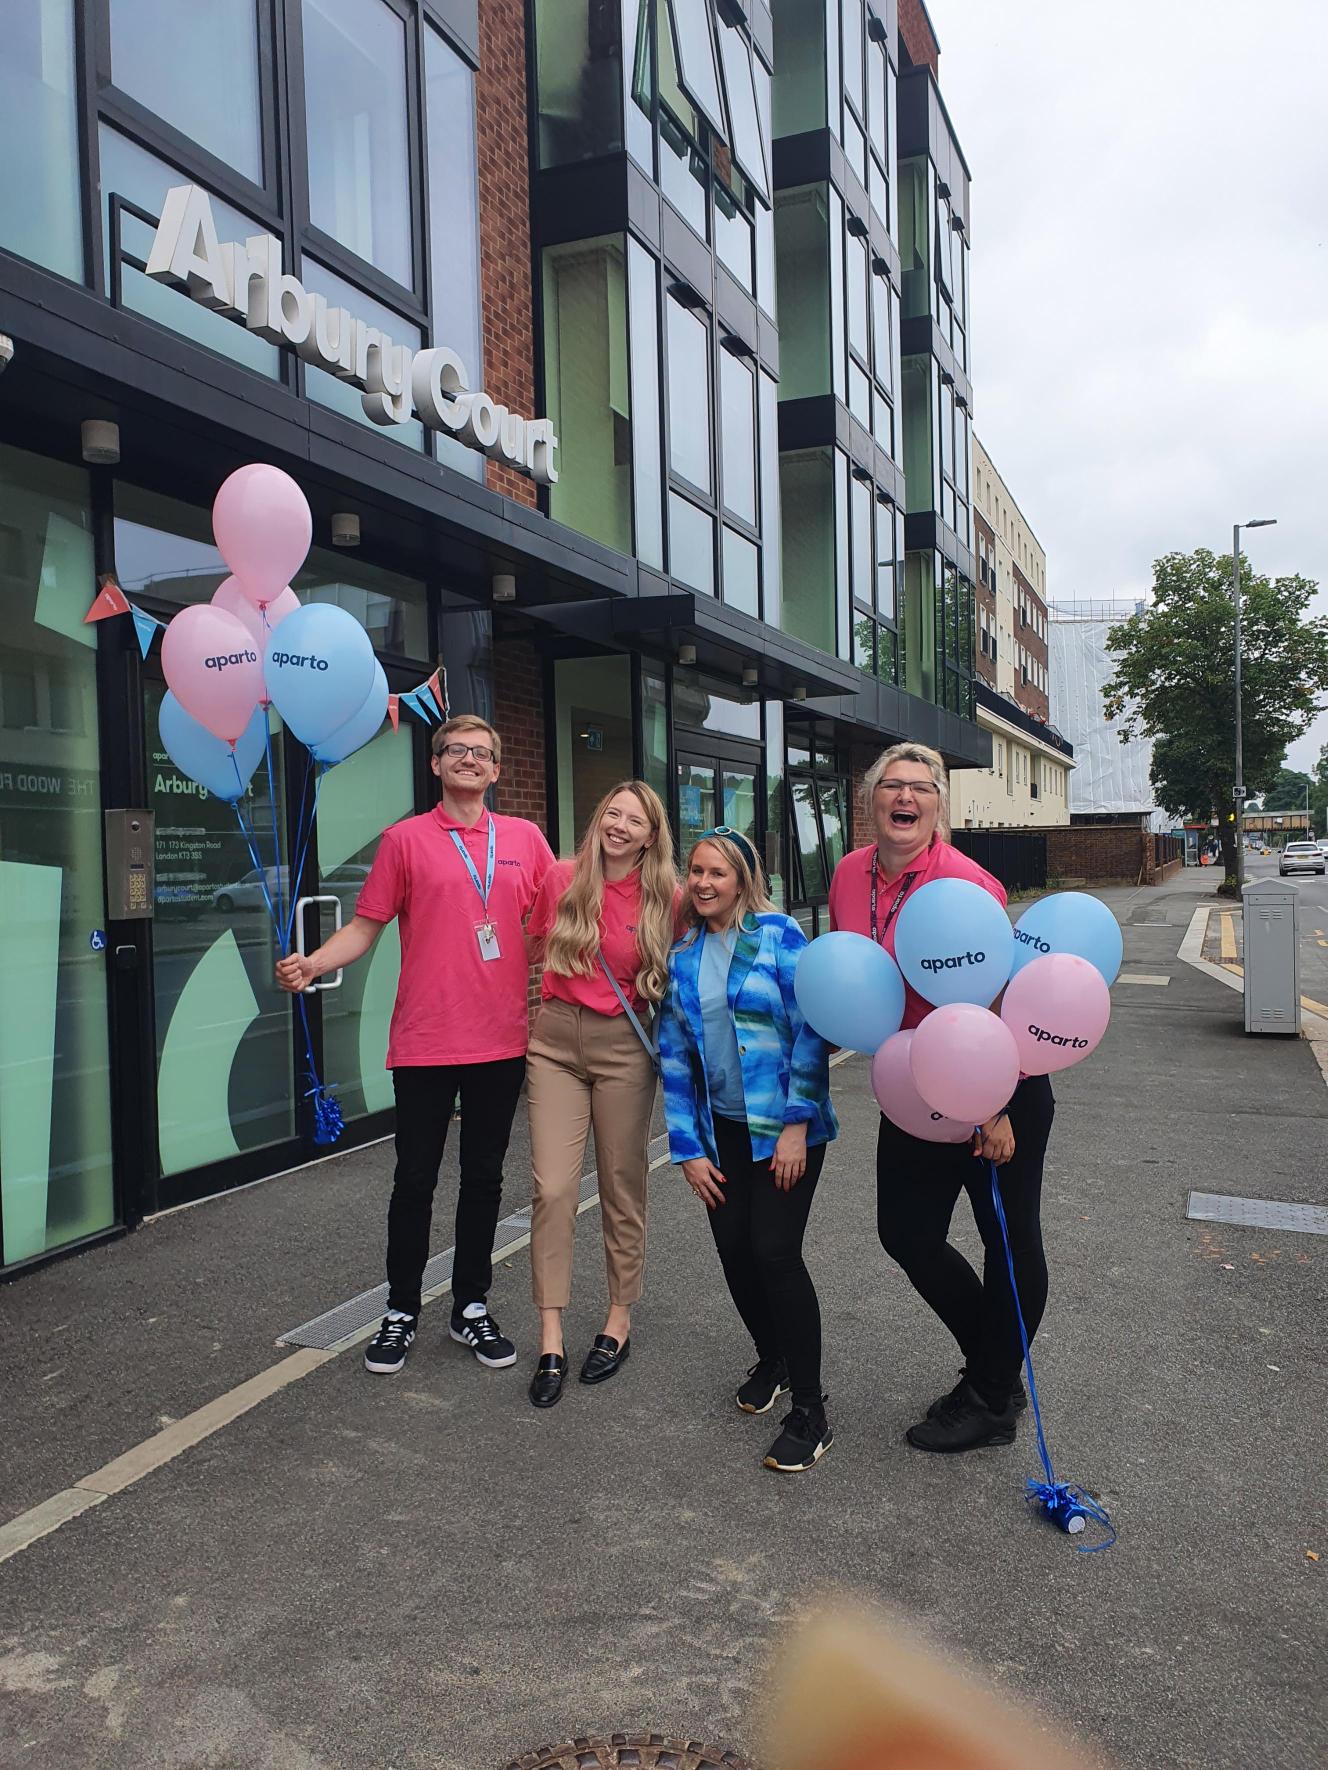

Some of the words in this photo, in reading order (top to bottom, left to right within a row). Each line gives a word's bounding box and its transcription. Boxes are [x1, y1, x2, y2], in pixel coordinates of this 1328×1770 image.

[146, 184, 412, 427] Arbury
[411, 346, 559, 485] Court
[204, 649, 257, 672] aparto
[271, 651, 329, 671] aparto
[152, 752, 169, 762] apar
[154, 773, 208, 800] Arbury
[155, 851, 178, 860] London
[180, 840, 206, 851] Kingston
[205, 840, 222, 849] Road
[890, 890, 905, 913] aparto
[920, 950, 986, 974] aparto
[1027, 1024, 1089, 1049] aparto
